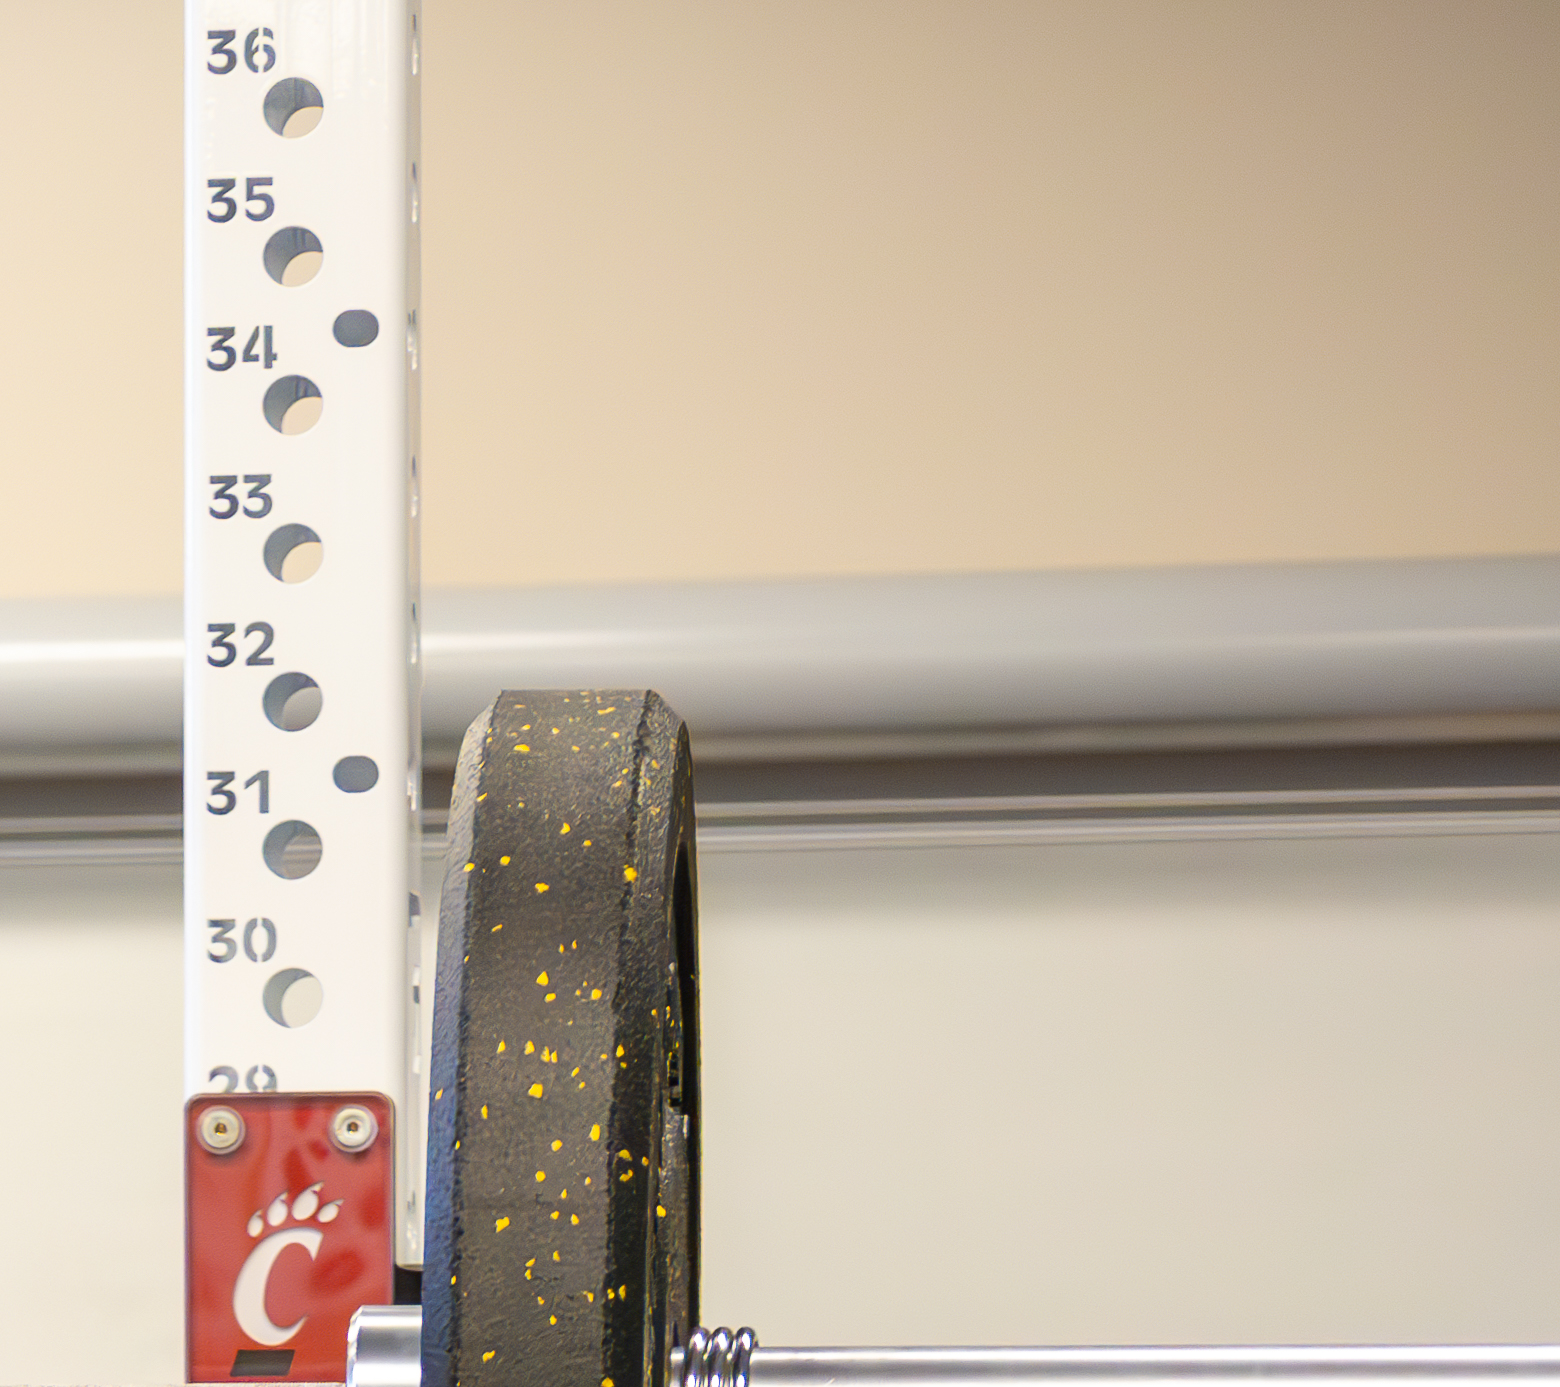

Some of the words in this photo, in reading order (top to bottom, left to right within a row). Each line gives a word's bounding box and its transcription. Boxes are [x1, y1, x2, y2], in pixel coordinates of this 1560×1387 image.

[206, 26, 277, 76] 36
[206, 176, 276, 224] 35
[205, 324, 279, 373] 34
[206, 473, 276, 521] 33
[206, 620, 276, 669] 32
[205, 769, 271, 817] 31
[206, 916, 278, 965] 30
[232, 1226, 325, 1347] C
